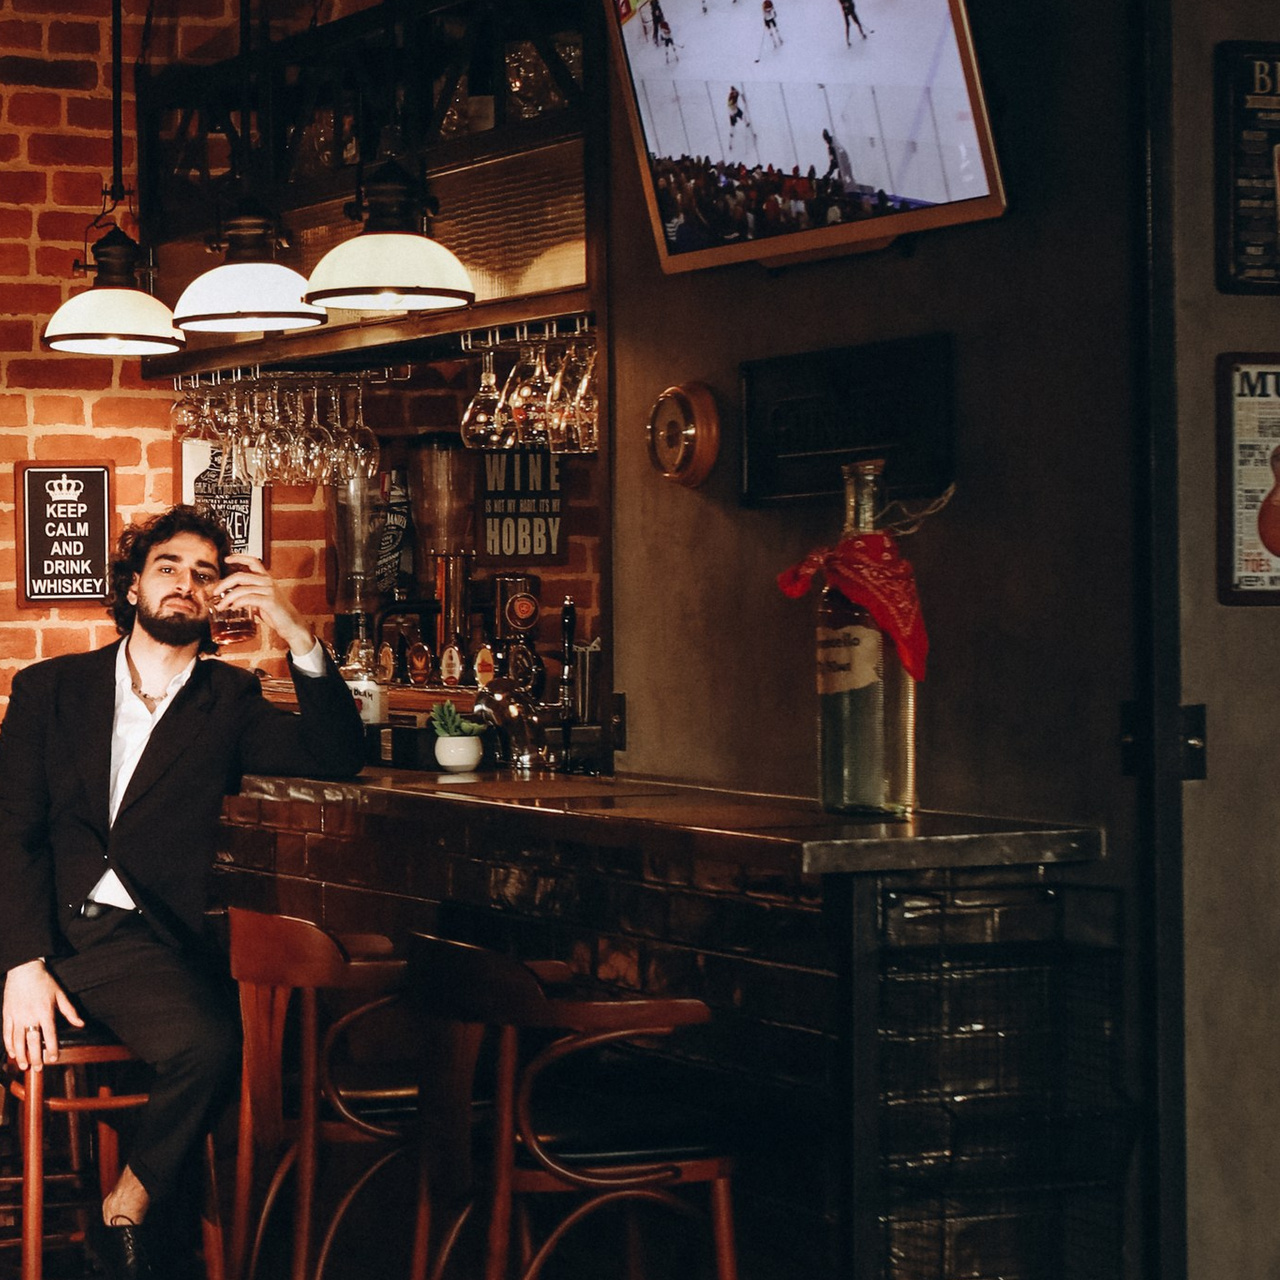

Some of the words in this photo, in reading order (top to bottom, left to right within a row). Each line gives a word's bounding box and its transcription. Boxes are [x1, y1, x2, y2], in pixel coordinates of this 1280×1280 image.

[485, 454, 560, 491] WINE
[46, 503, 88, 518] KEEP
[45, 522, 89, 537] CALM
[486, 517, 561, 555] HOBBY
[50, 540, 84, 556] AND
[43, 560, 92, 575] DRINK
[31, 578, 103, 594] WHISKEY
[353, 687, 373, 701] BEAM
